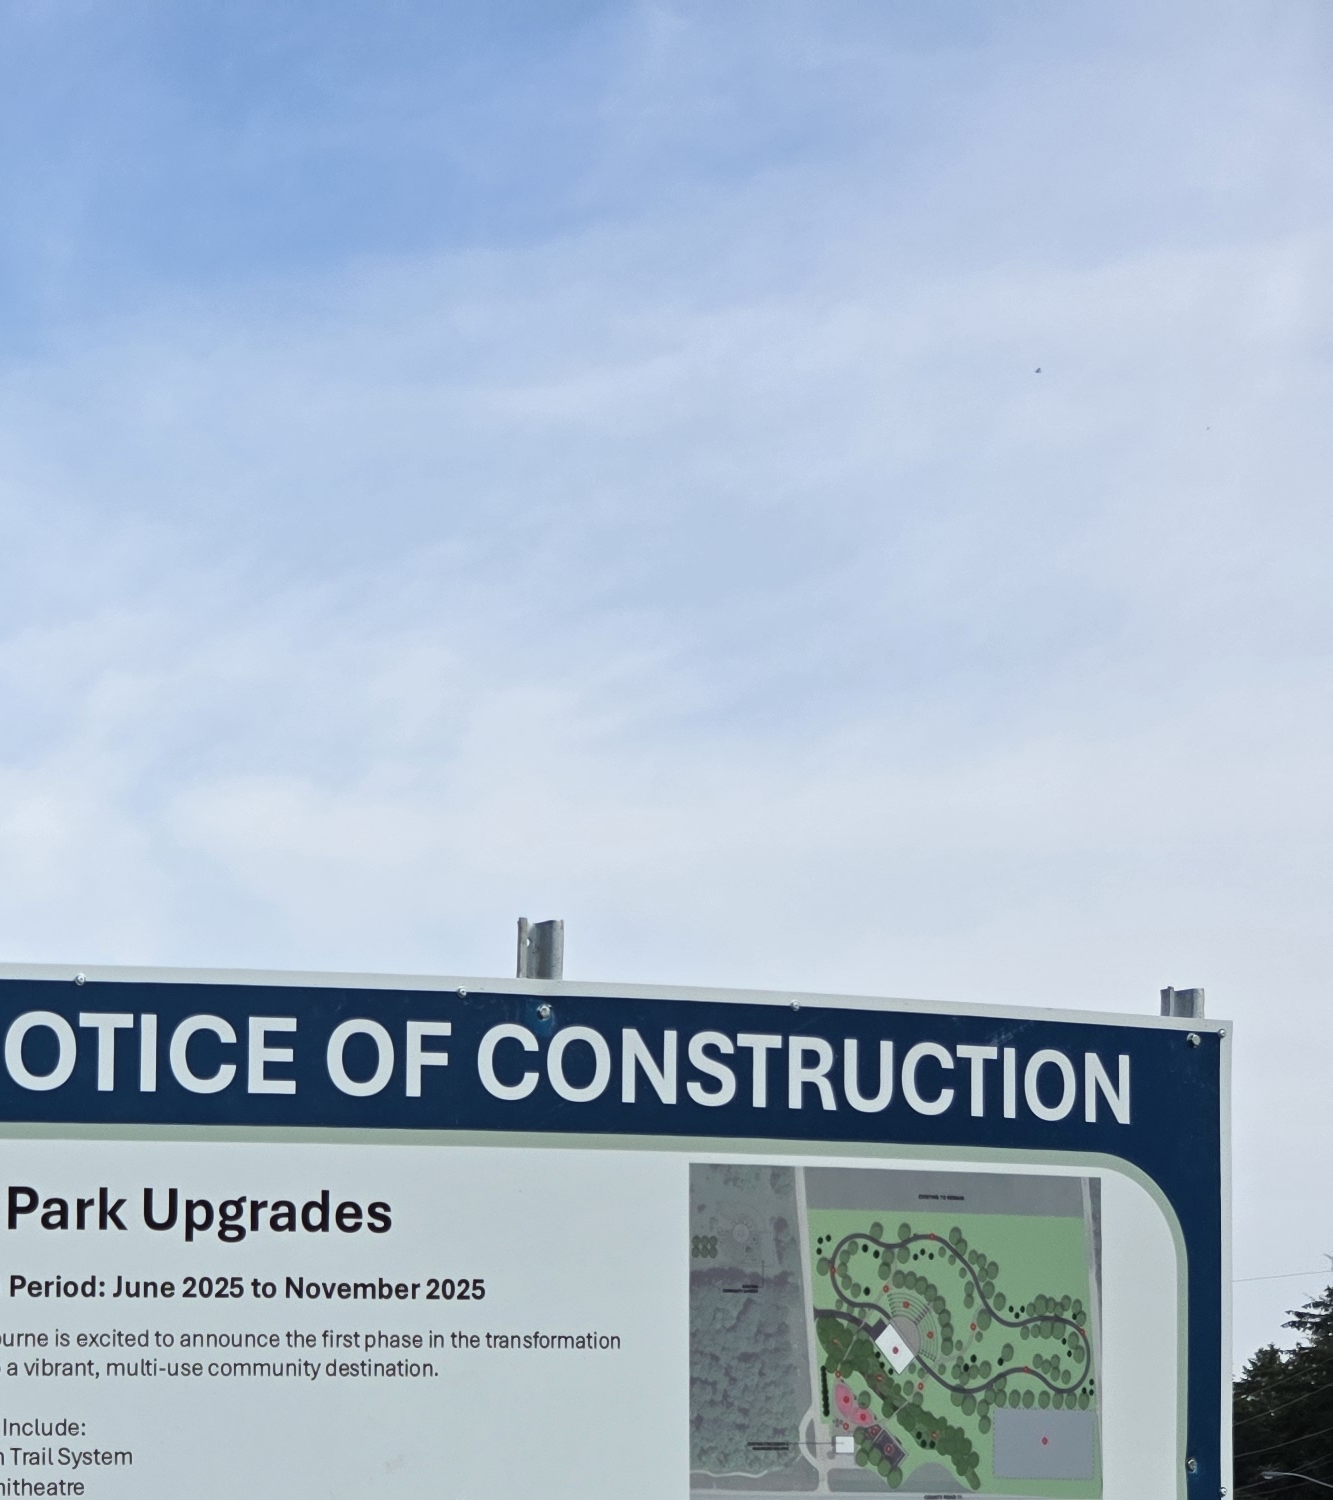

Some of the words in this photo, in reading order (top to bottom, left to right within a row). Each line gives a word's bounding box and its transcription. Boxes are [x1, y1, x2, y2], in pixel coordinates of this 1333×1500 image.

[326, 1018, 452, 1098] OF
[477, 1022, 1131, 1125] CONSTRUCTION
[7, 1185, 128, 1231] Park
[143, 1187, 392, 1244] Upgrades
[9, 1274, 106, 1298] Period:
[112, 1275, 176, 1299] June
[181, 1276, 245, 1299] 2025
[250, 1278, 277, 1299] to
[285, 1276, 421, 1300] November
[425, 1278, 486, 1301] 2025
[55, 1328, 71, 1348] is
[76, 1328, 149, 1348] excited
[154, 1330, 175, 1348] to
[179, 1333, 280, 1348] announce
[285, 1329, 317, 1349] the
[321, 1329, 361, 1349] first
[364, 1329, 424, 1353] phase
[428, 1329, 445, 1349] in
[450, 1330, 481, 1349] the
[484, 1330, 621, 1350] transformation
[6, 1361, 18, 1377] a
[23, 1357, 100, 1380] vibrant,
[106, 1357, 204, 1377] multi-use
[207, 1358, 322, 1381] community
[325, 1358, 439, 1378] destination.
[3, 1417, 86, 1437] Include:
[9, 1446, 54, 1466] Trail
[57, 1447, 133, 1470] System
